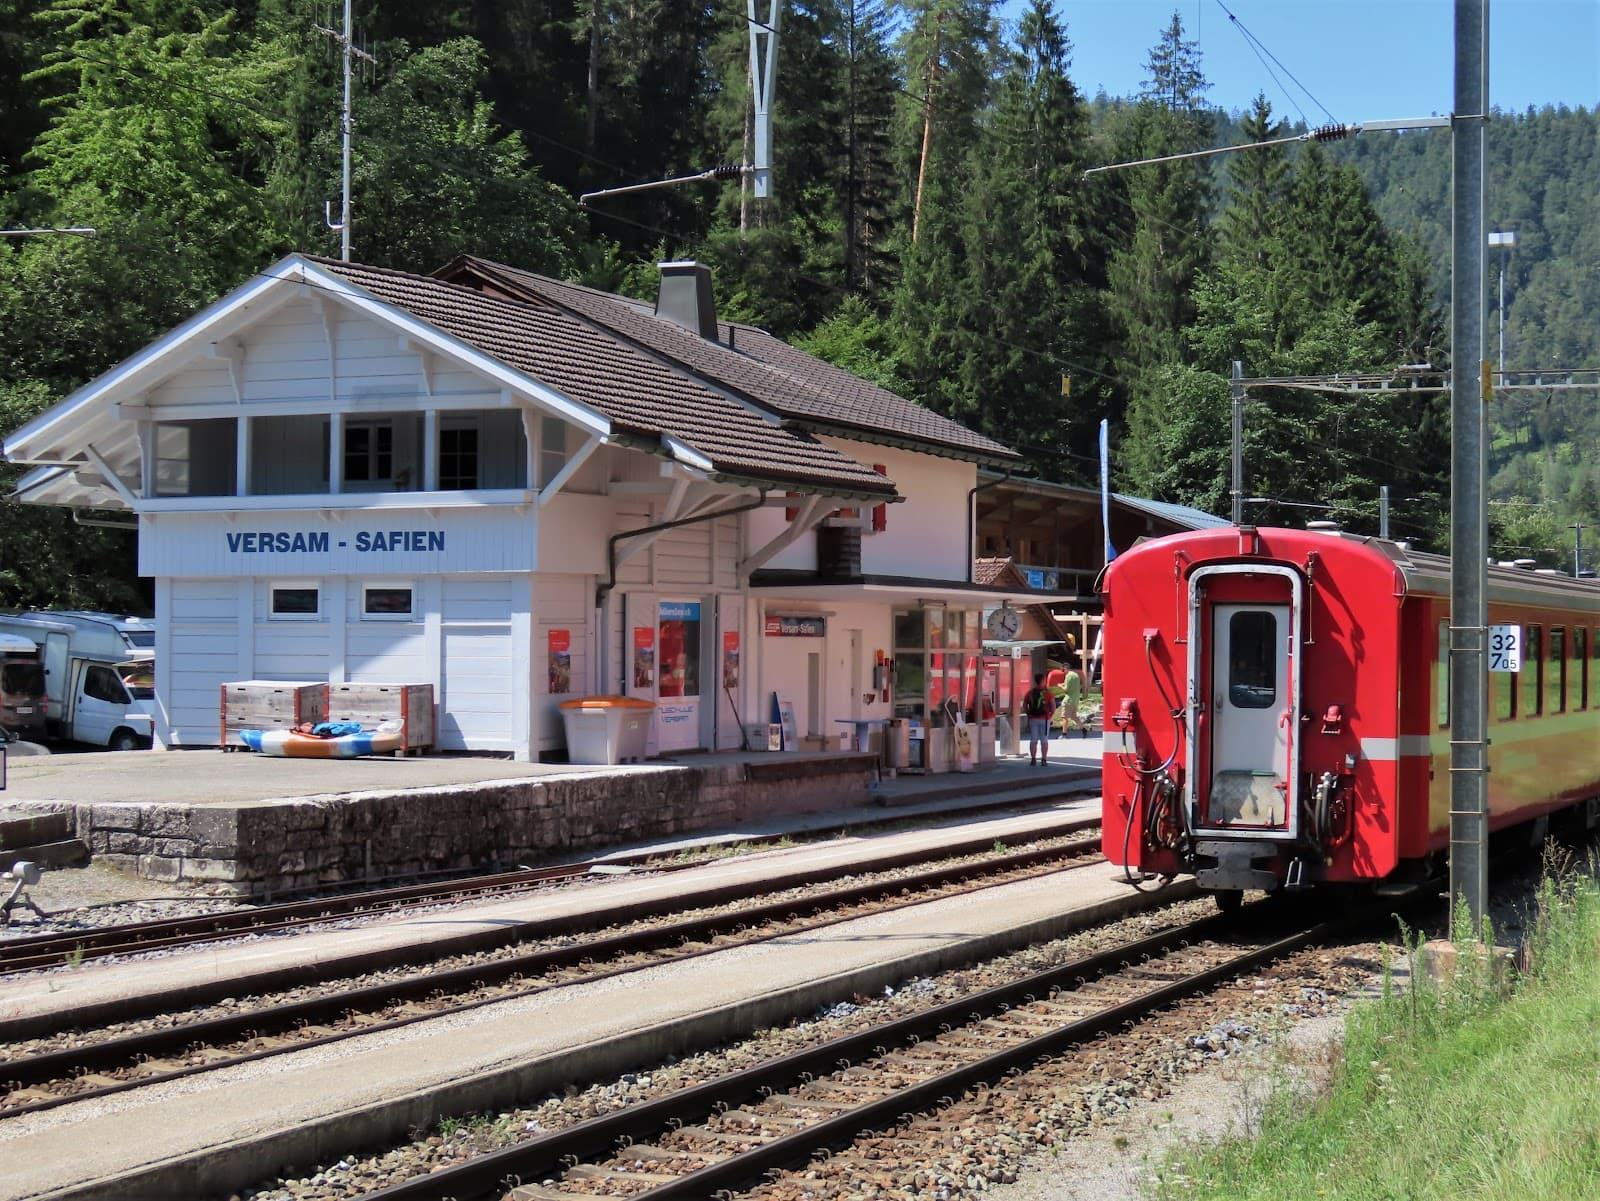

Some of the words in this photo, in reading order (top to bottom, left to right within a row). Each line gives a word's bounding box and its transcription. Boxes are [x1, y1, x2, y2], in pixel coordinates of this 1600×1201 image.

[226, 532, 329, 553] VERSAM
[355, 531, 445, 552] SAFIEN
[1492, 634, 1516, 651] 32
